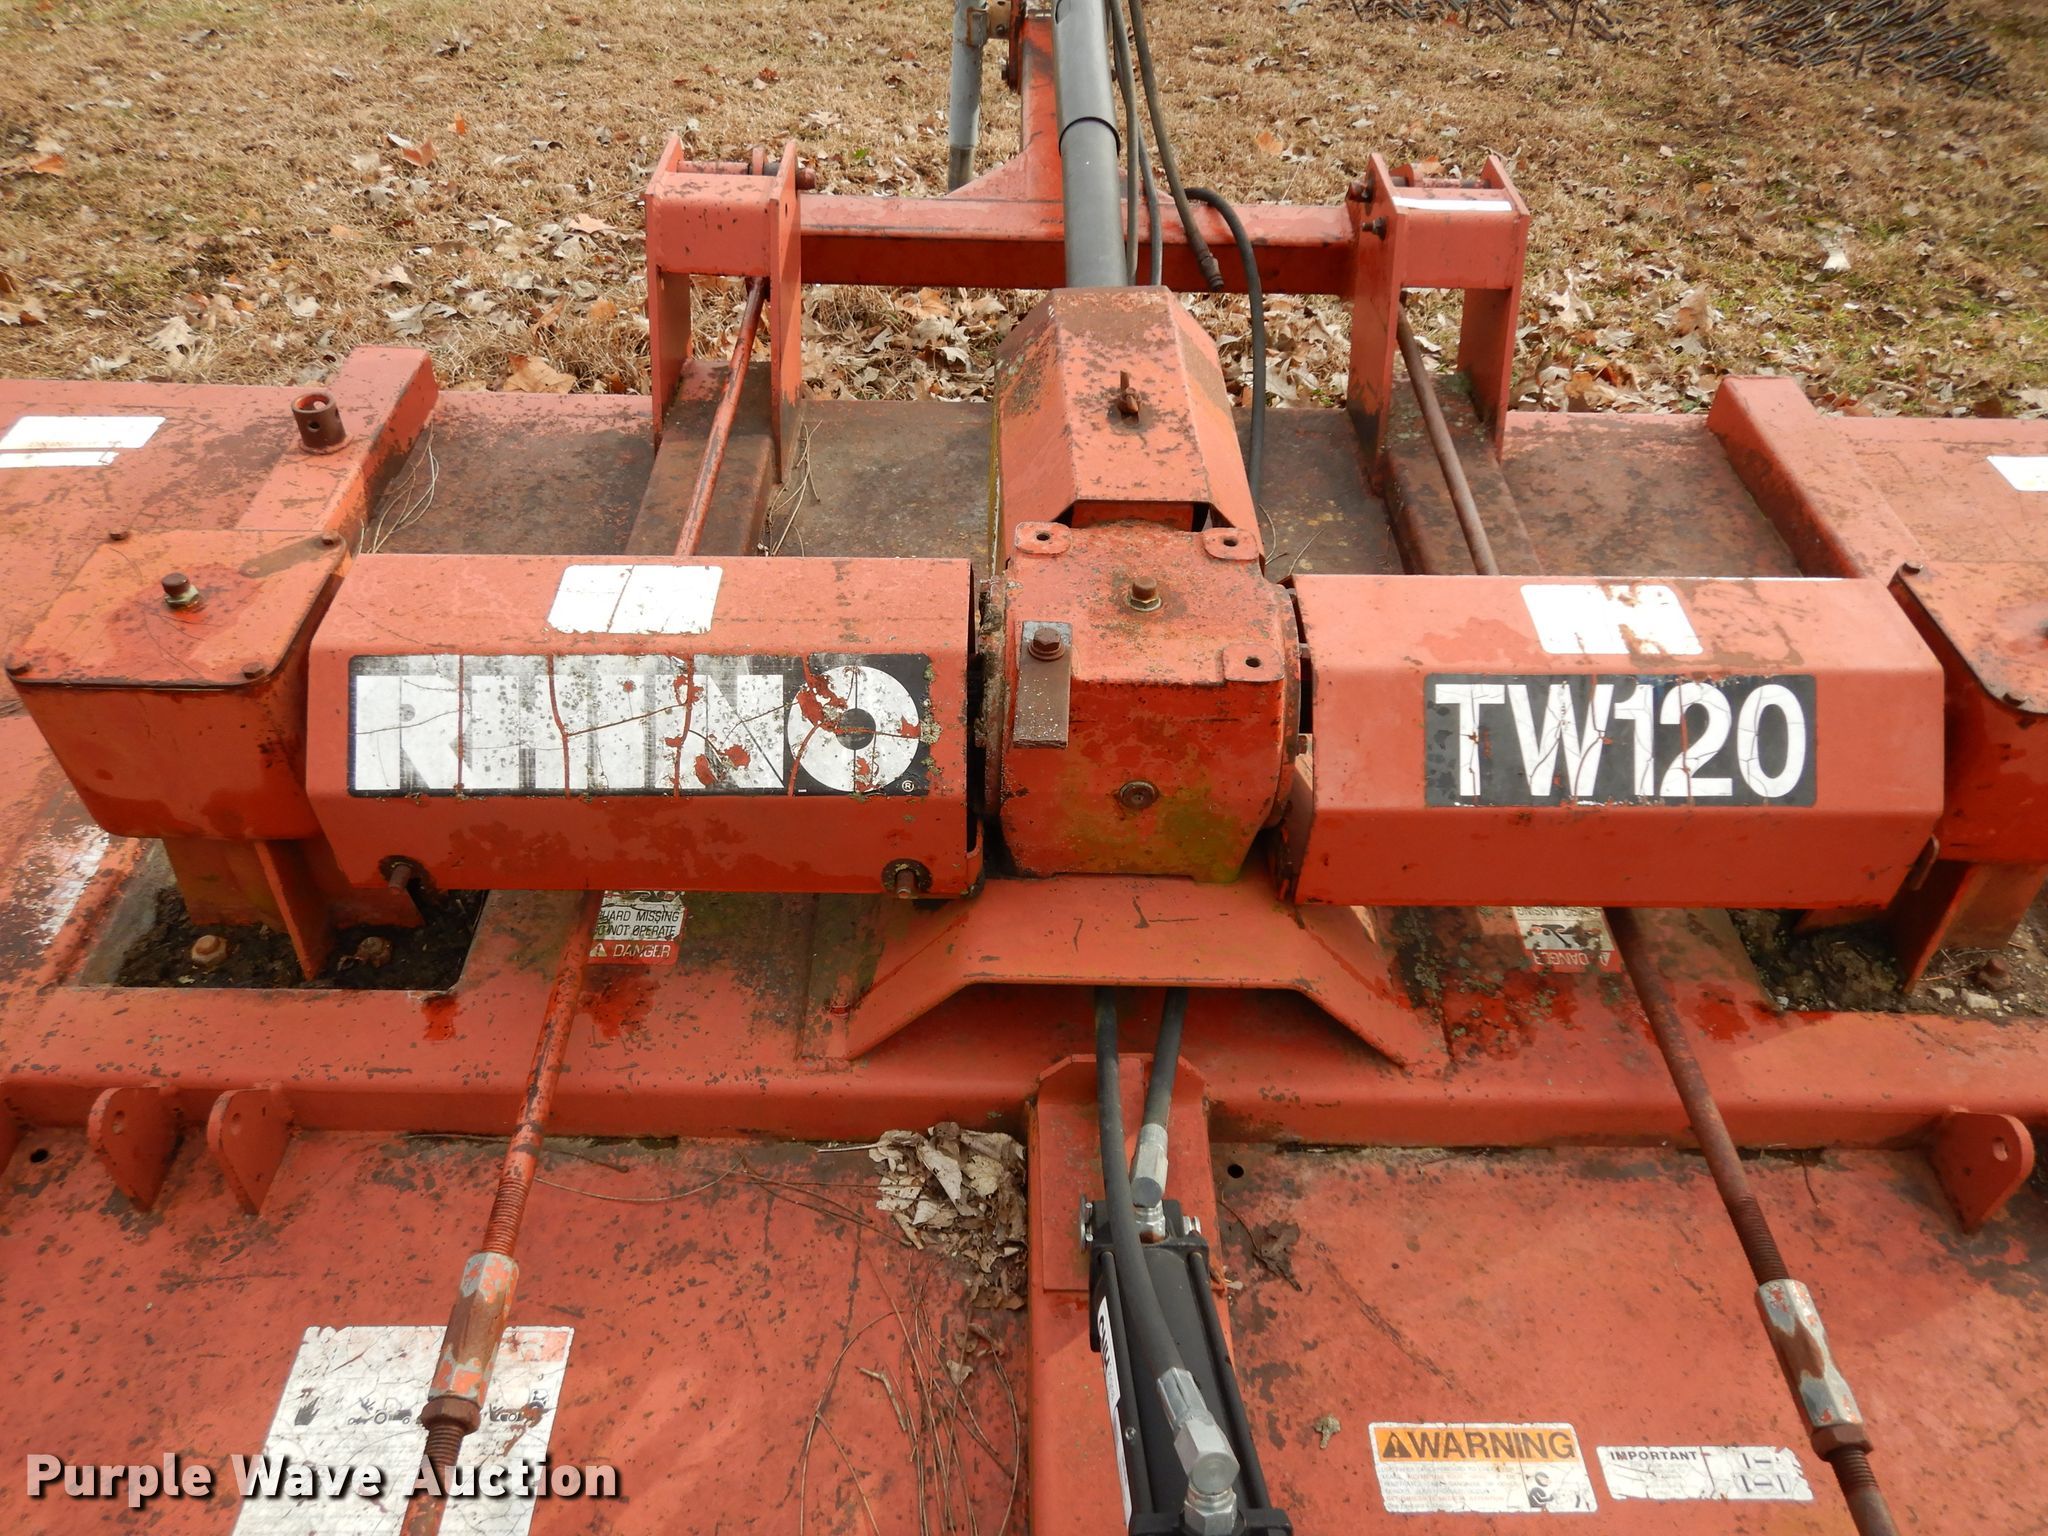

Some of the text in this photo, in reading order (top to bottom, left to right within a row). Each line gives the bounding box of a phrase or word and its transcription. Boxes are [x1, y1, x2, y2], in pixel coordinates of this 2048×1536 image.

[356, 665, 921, 792] RHINO
[1434, 682, 1807, 799] TW120
[635, 910, 680, 922] MISSING
[608, 925, 632, 936] NOT
[633, 925, 677, 937] OPERATE
[613, 943, 672, 958] DANGER
[1408, 1430, 1576, 1460] WARNING
[1609, 1449, 1698, 1463] IMPORTANT
